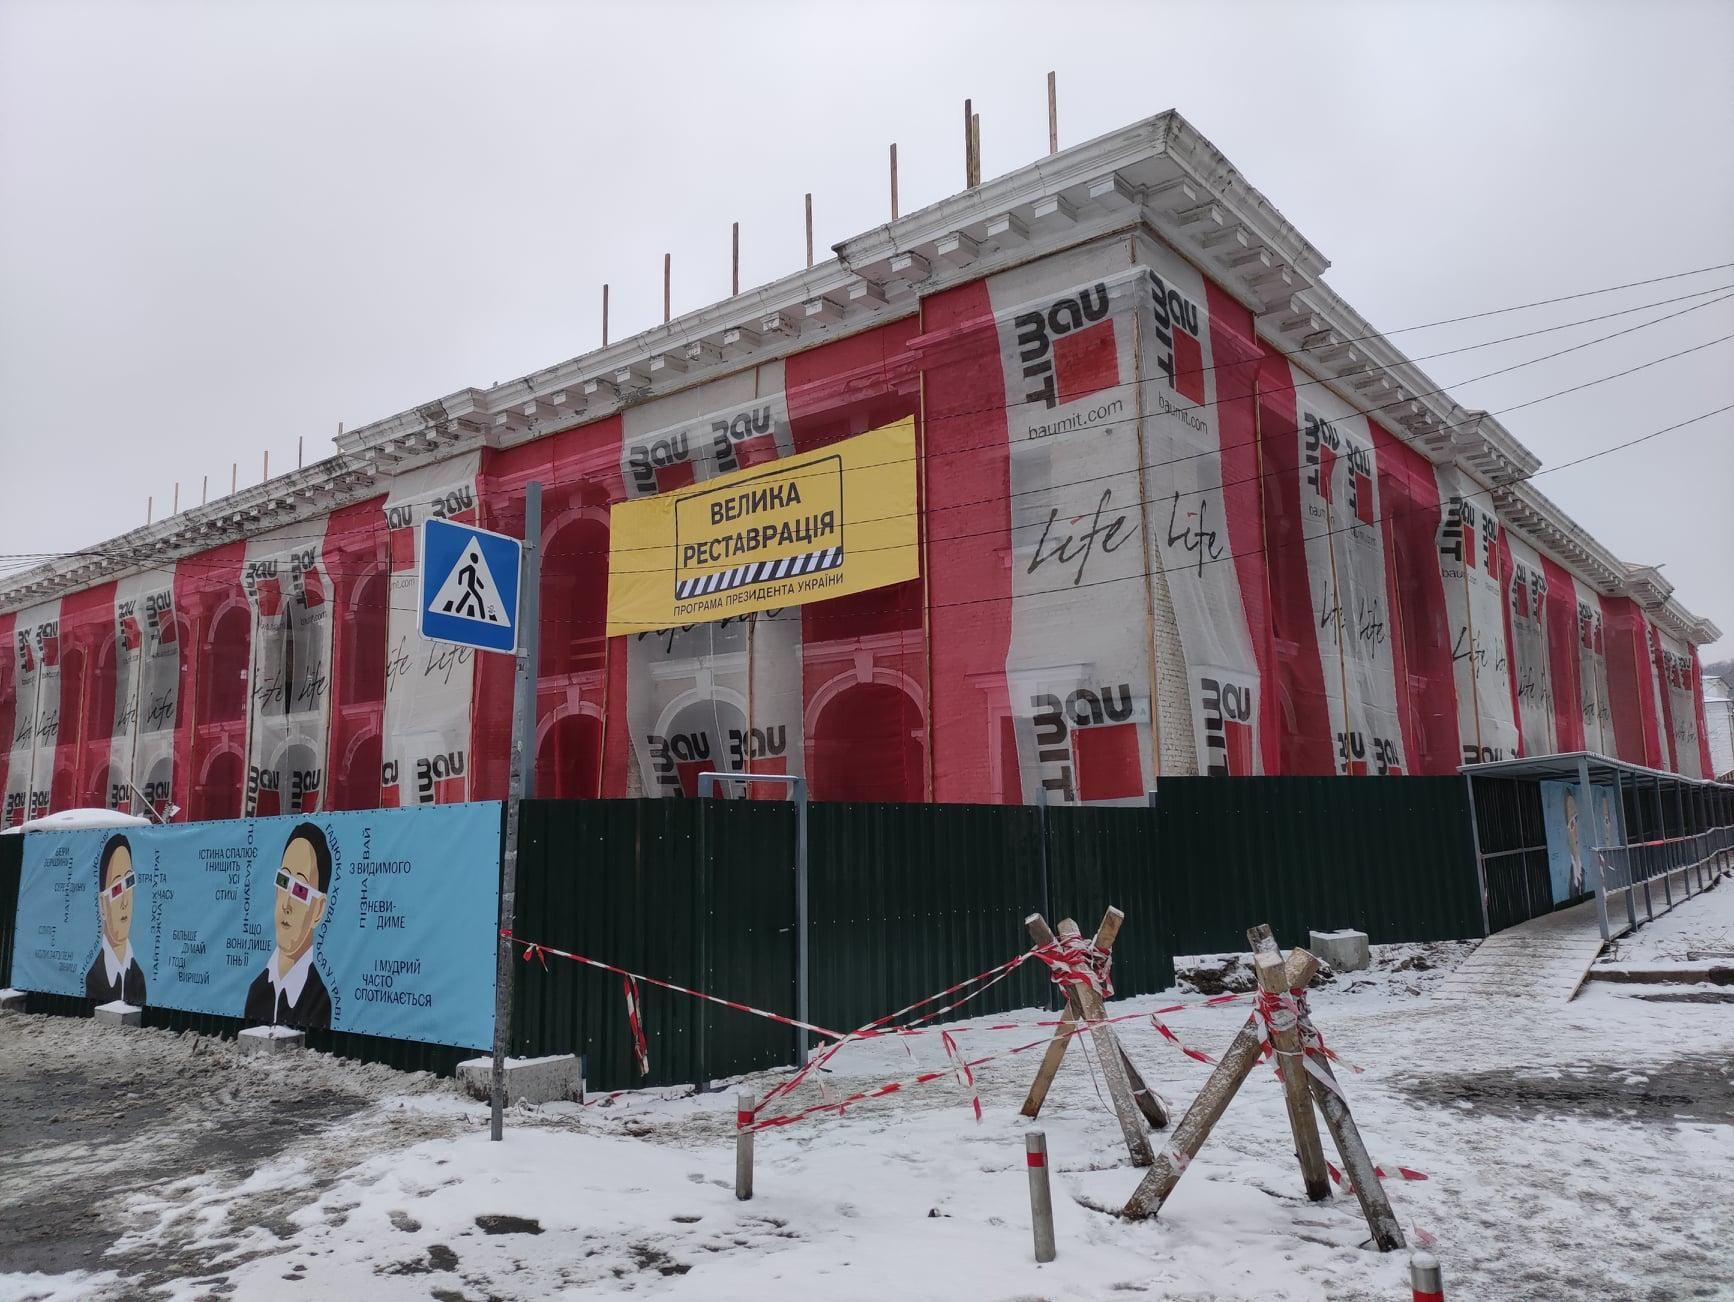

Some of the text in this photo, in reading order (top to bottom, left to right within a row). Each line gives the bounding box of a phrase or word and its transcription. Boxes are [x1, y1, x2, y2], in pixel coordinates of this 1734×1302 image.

[1028, 399, 1123, 439] baumit.com
[1158, 392, 1208, 435] baumit.com
[710, 481, 801, 526] ВЕЛИКА
[683, 510, 836, 568] РЕСТАВРАЦІЯ
[1028, 488, 1140, 585] Life
[1167, 491, 1223, 577] Life
[673, 572, 844, 617] ПРОГРАМА ПРЕЗИДЕНТА УКРАЇНИ
[199, 846, 258, 860] ІСТИНА СПАЛЮЄ
[325, 823, 342, 881] ГАДЮКА
[209, 860, 241, 874] НИЩИТЬ
[349, 861, 412, 876] З ВИДИМОГО
[228, 874, 240, 885] УСІ
[367, 900, 397, 913] НЕВИ-
[249, 923, 262, 936] ЩО
[377, 916, 406, 930] ДИМЕ
[226, 938, 272, 951] ВОНИ ЛИШЕ
[226, 954, 243, 967] ТІНЬ
[379, 958, 421, 976] МУДРИЙ
[325, 966, 334, 977] У
[362, 974, 393, 988] ЧАСТО
[330, 977, 342, 1021] ТРАВІ
[354, 987, 432, 1008] СПОТИКАЄТЬСЯ
